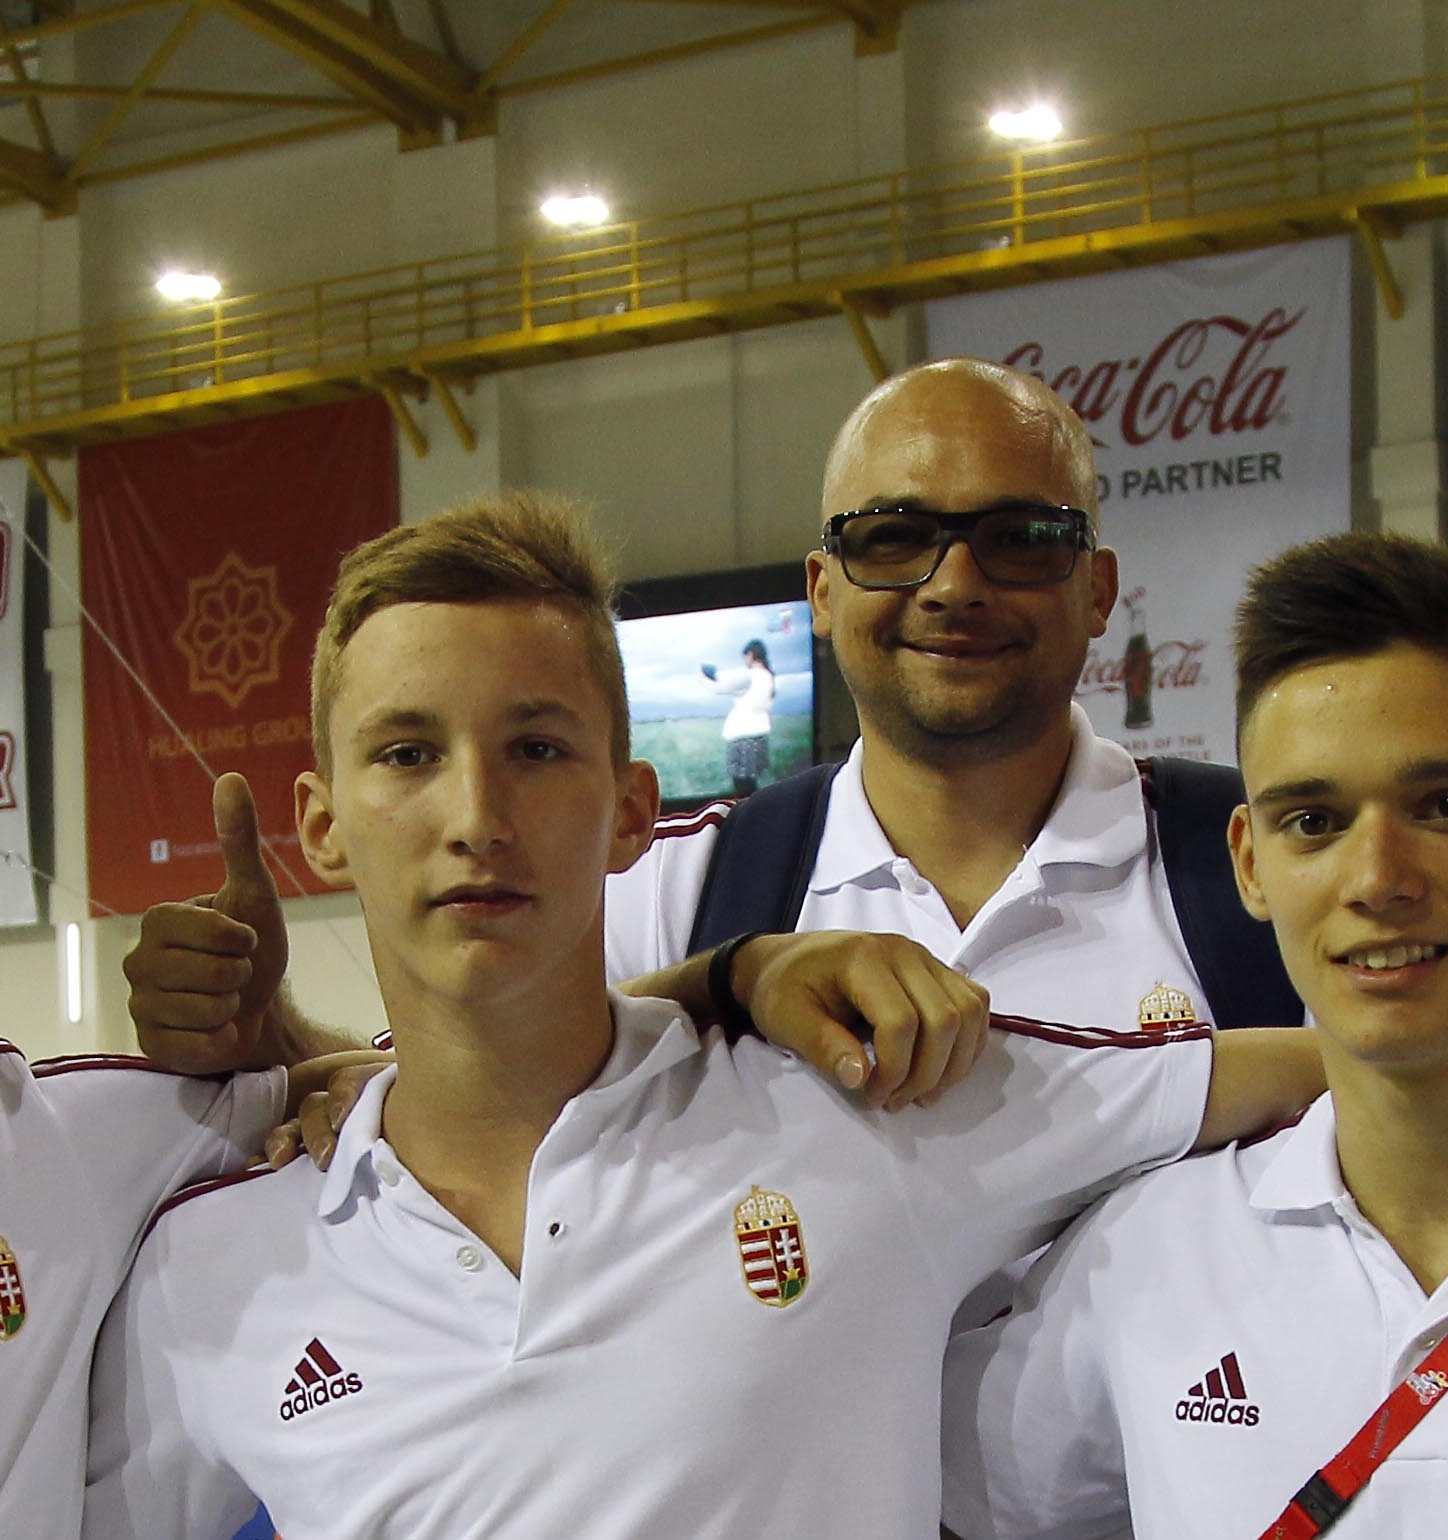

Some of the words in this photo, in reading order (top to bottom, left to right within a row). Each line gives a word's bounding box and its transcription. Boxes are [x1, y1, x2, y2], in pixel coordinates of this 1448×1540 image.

[1122, 452, 1284, 499] PARTNER
[280, 1372, 363, 1421] adidas
[1175, 1396, 1260, 1427] adidas
